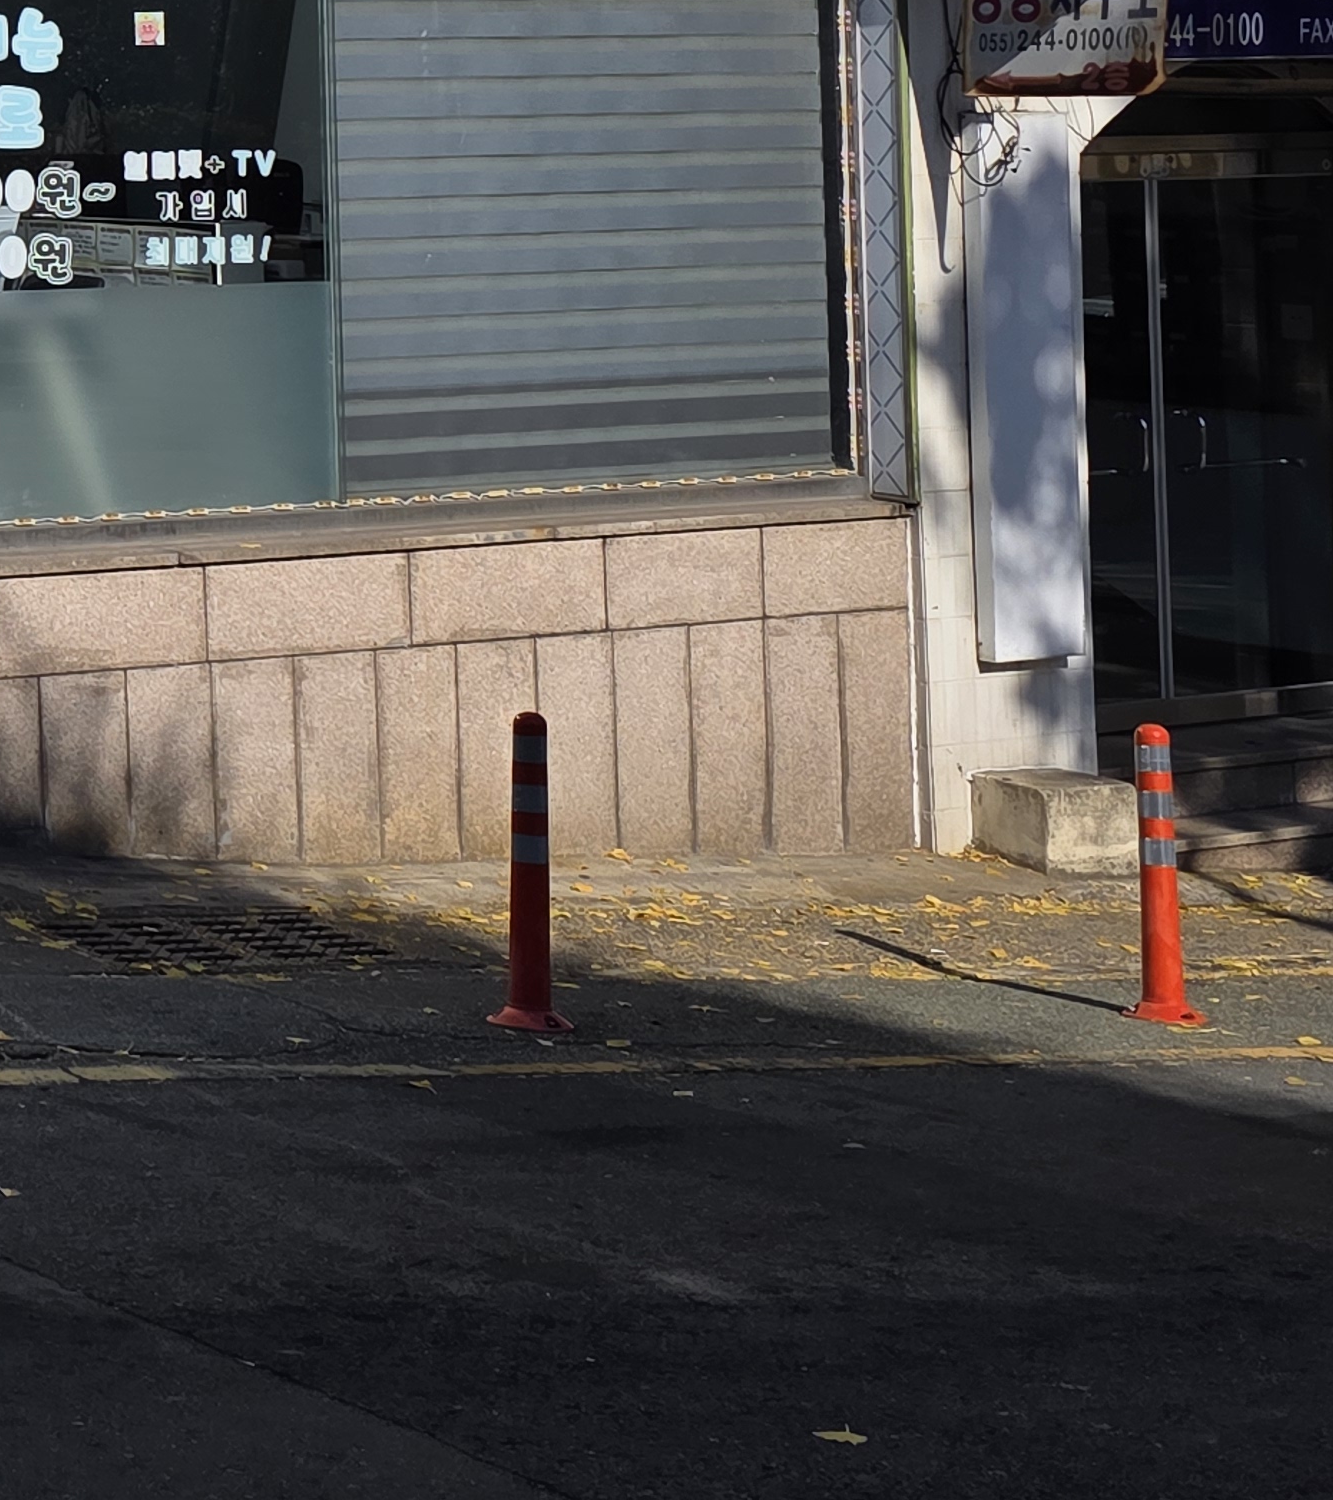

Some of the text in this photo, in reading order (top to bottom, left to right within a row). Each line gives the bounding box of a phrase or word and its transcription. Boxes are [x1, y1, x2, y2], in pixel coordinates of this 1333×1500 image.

[1164, 12, 1264, 47] 44-0100
[1081, 61, 1130, 90] 2층
[232, 150, 276, 177] TV
